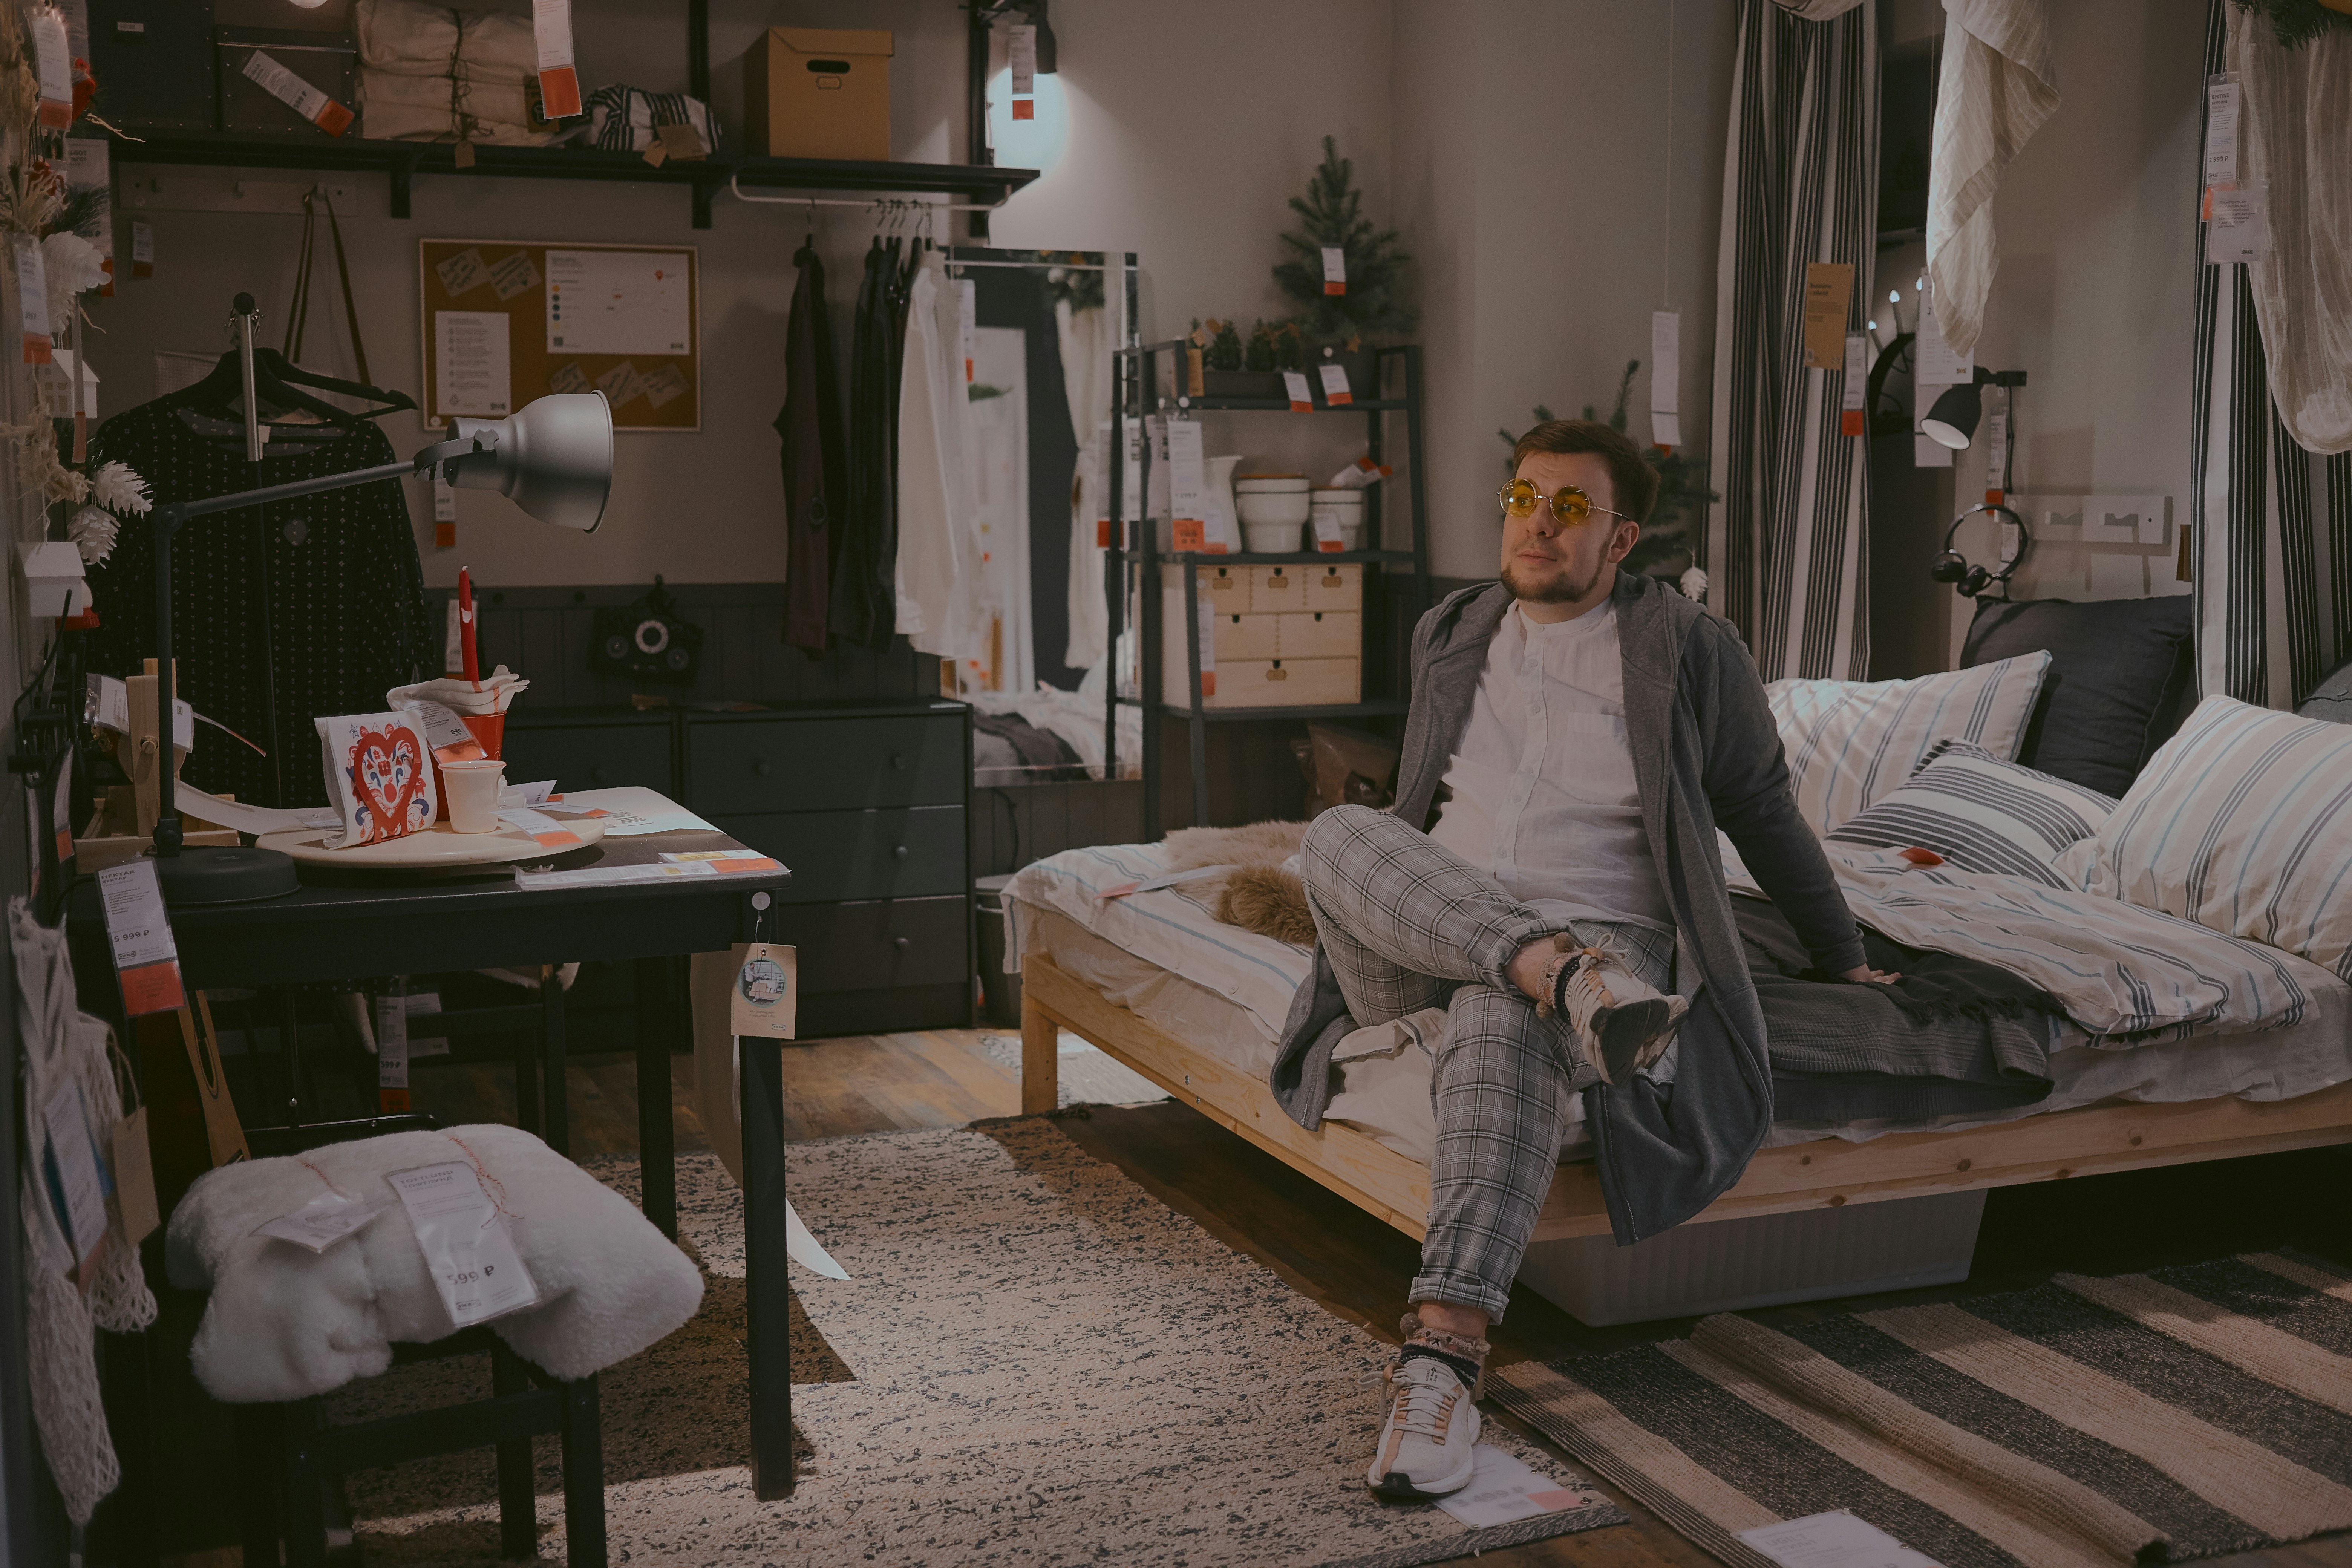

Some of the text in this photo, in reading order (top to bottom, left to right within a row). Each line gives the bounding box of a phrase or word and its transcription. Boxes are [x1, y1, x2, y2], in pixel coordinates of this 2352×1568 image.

[101, 870, 135, 879] HEKTAR
[122, 931, 141, 941] 999
[400, 1170, 454, 1184] TOFTLUND
[403, 1176, 454, 1189] ТОФТЛУНД
[447, 1271, 479, 1284] 599
[1765, 1533, 1808, 1547] UGILT
